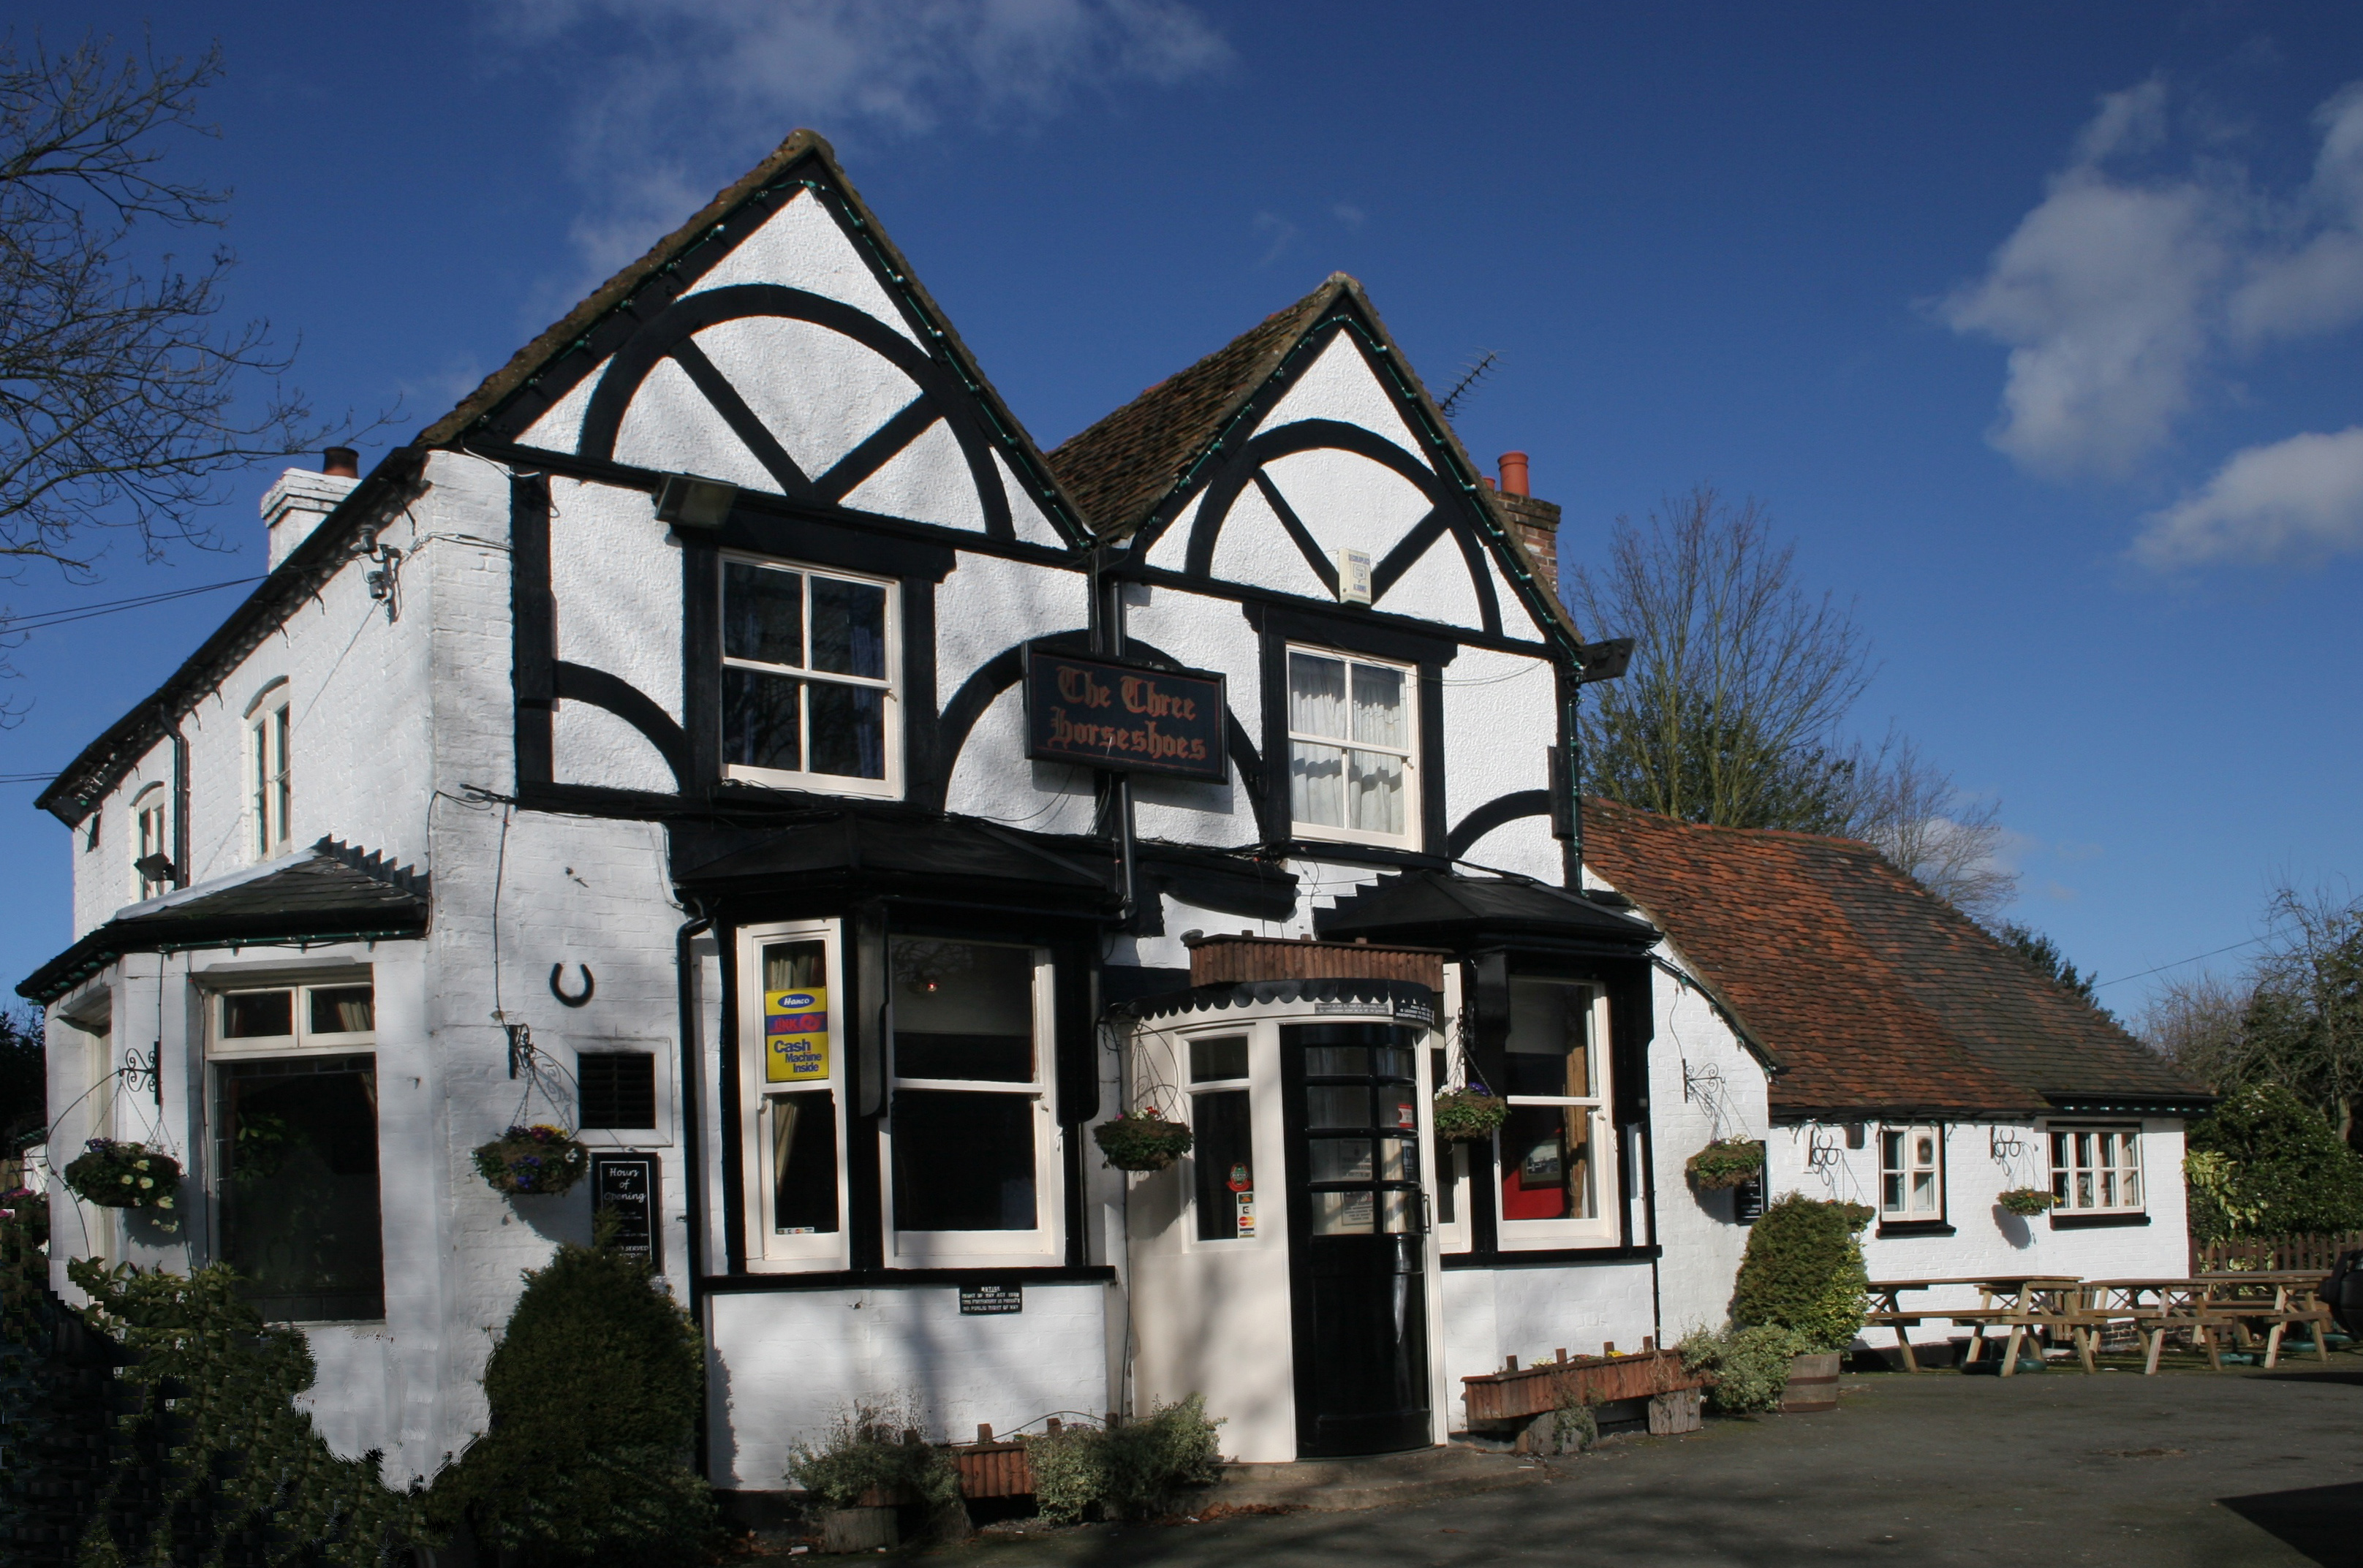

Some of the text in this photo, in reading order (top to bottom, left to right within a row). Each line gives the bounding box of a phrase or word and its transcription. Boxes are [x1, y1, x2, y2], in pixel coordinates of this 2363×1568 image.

[1056, 666, 1196, 721] The Three
[774, 1039, 811, 1053] Cash
[785, 1053, 822, 1063] Machine
[793, 1062, 819, 1072] Inside
[609, 1167, 640, 1177] Hours
[619, 1178, 630, 1189] of
[604, 1192, 647, 1202] Opening
